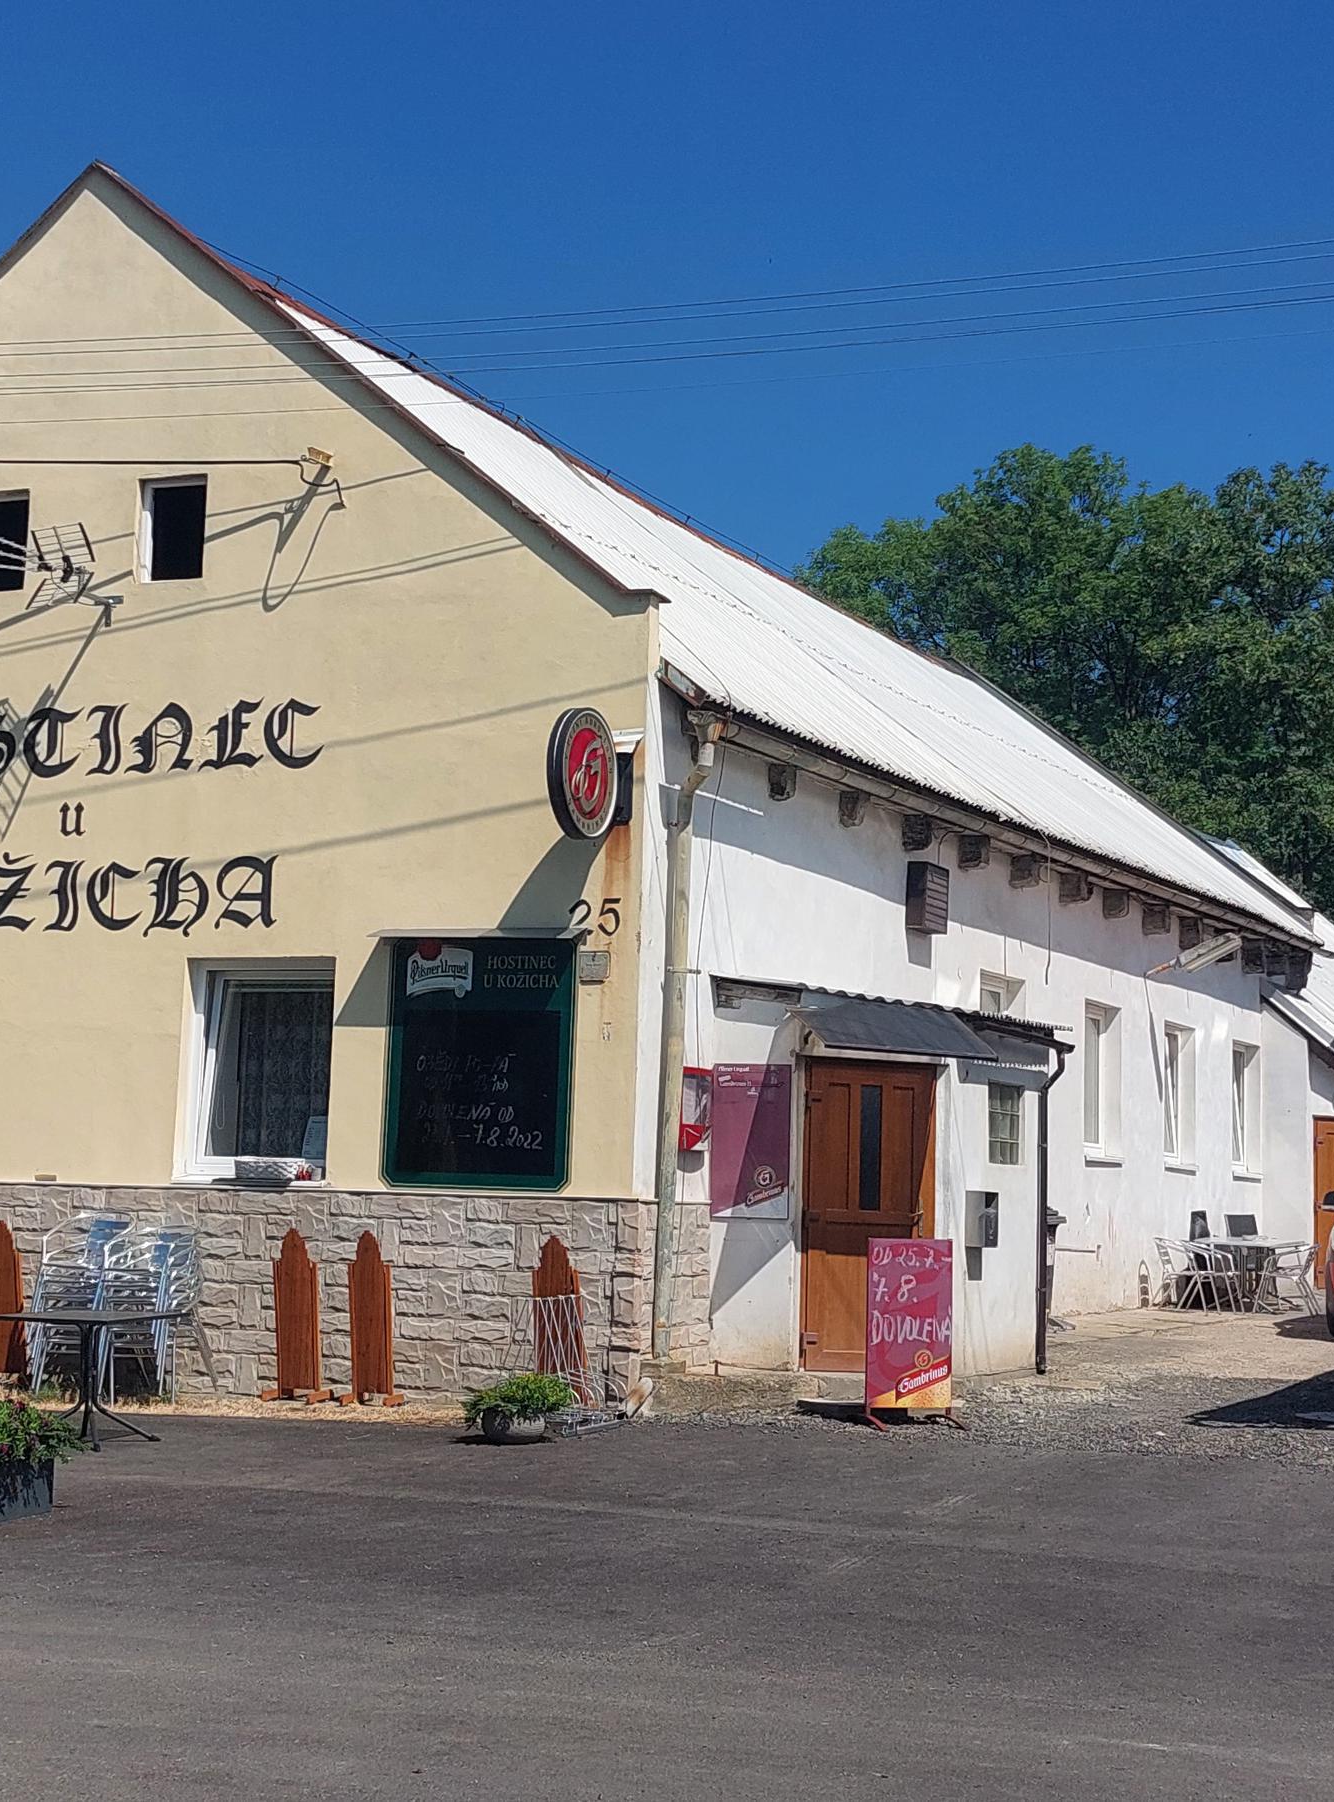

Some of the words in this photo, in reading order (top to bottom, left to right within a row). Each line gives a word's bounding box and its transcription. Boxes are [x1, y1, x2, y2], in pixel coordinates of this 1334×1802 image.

[568, 897, 622, 937] 25
[410, 958, 441, 986] Pilsner
[441, 957, 469, 980] Urquell
[487, 955, 556, 970] HOSTINEC
[483, 976, 493, 988] U
[497, 971, 560, 989] KOŽICHA
[872, 1246, 892, 1265] OD
[870, 1305, 952, 1346] DOVOLENÁ
[898, 1364, 948, 1393] Gambrinus
